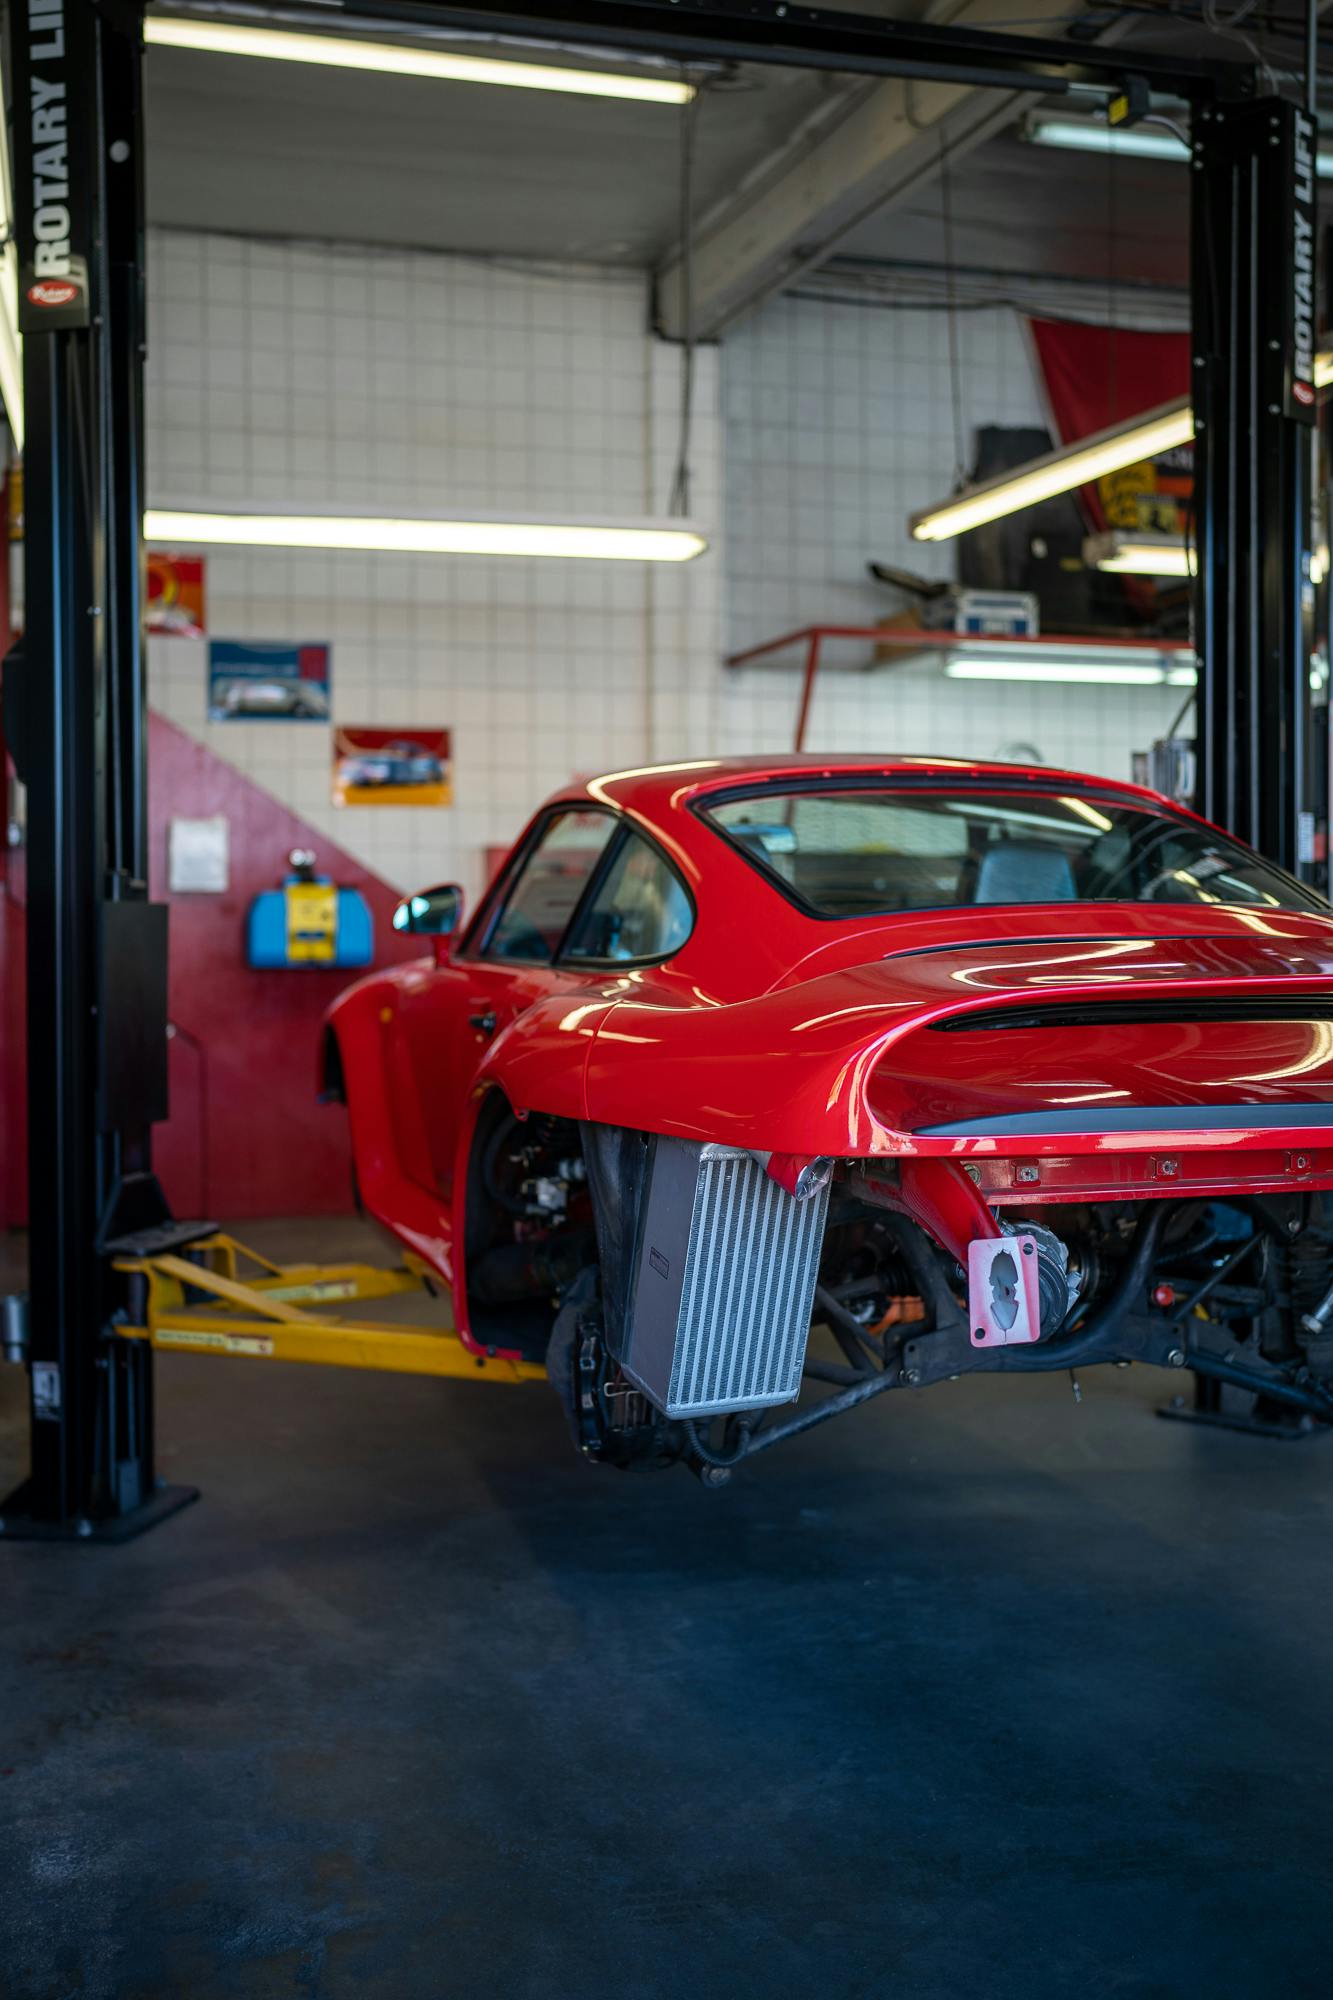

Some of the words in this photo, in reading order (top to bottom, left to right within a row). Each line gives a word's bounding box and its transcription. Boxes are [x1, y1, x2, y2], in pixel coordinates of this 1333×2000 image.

[31, 76, 70, 277] ROTARY
[1295, 110, 1313, 204] LIFT
[1295, 211, 1313, 382] ROTARY
